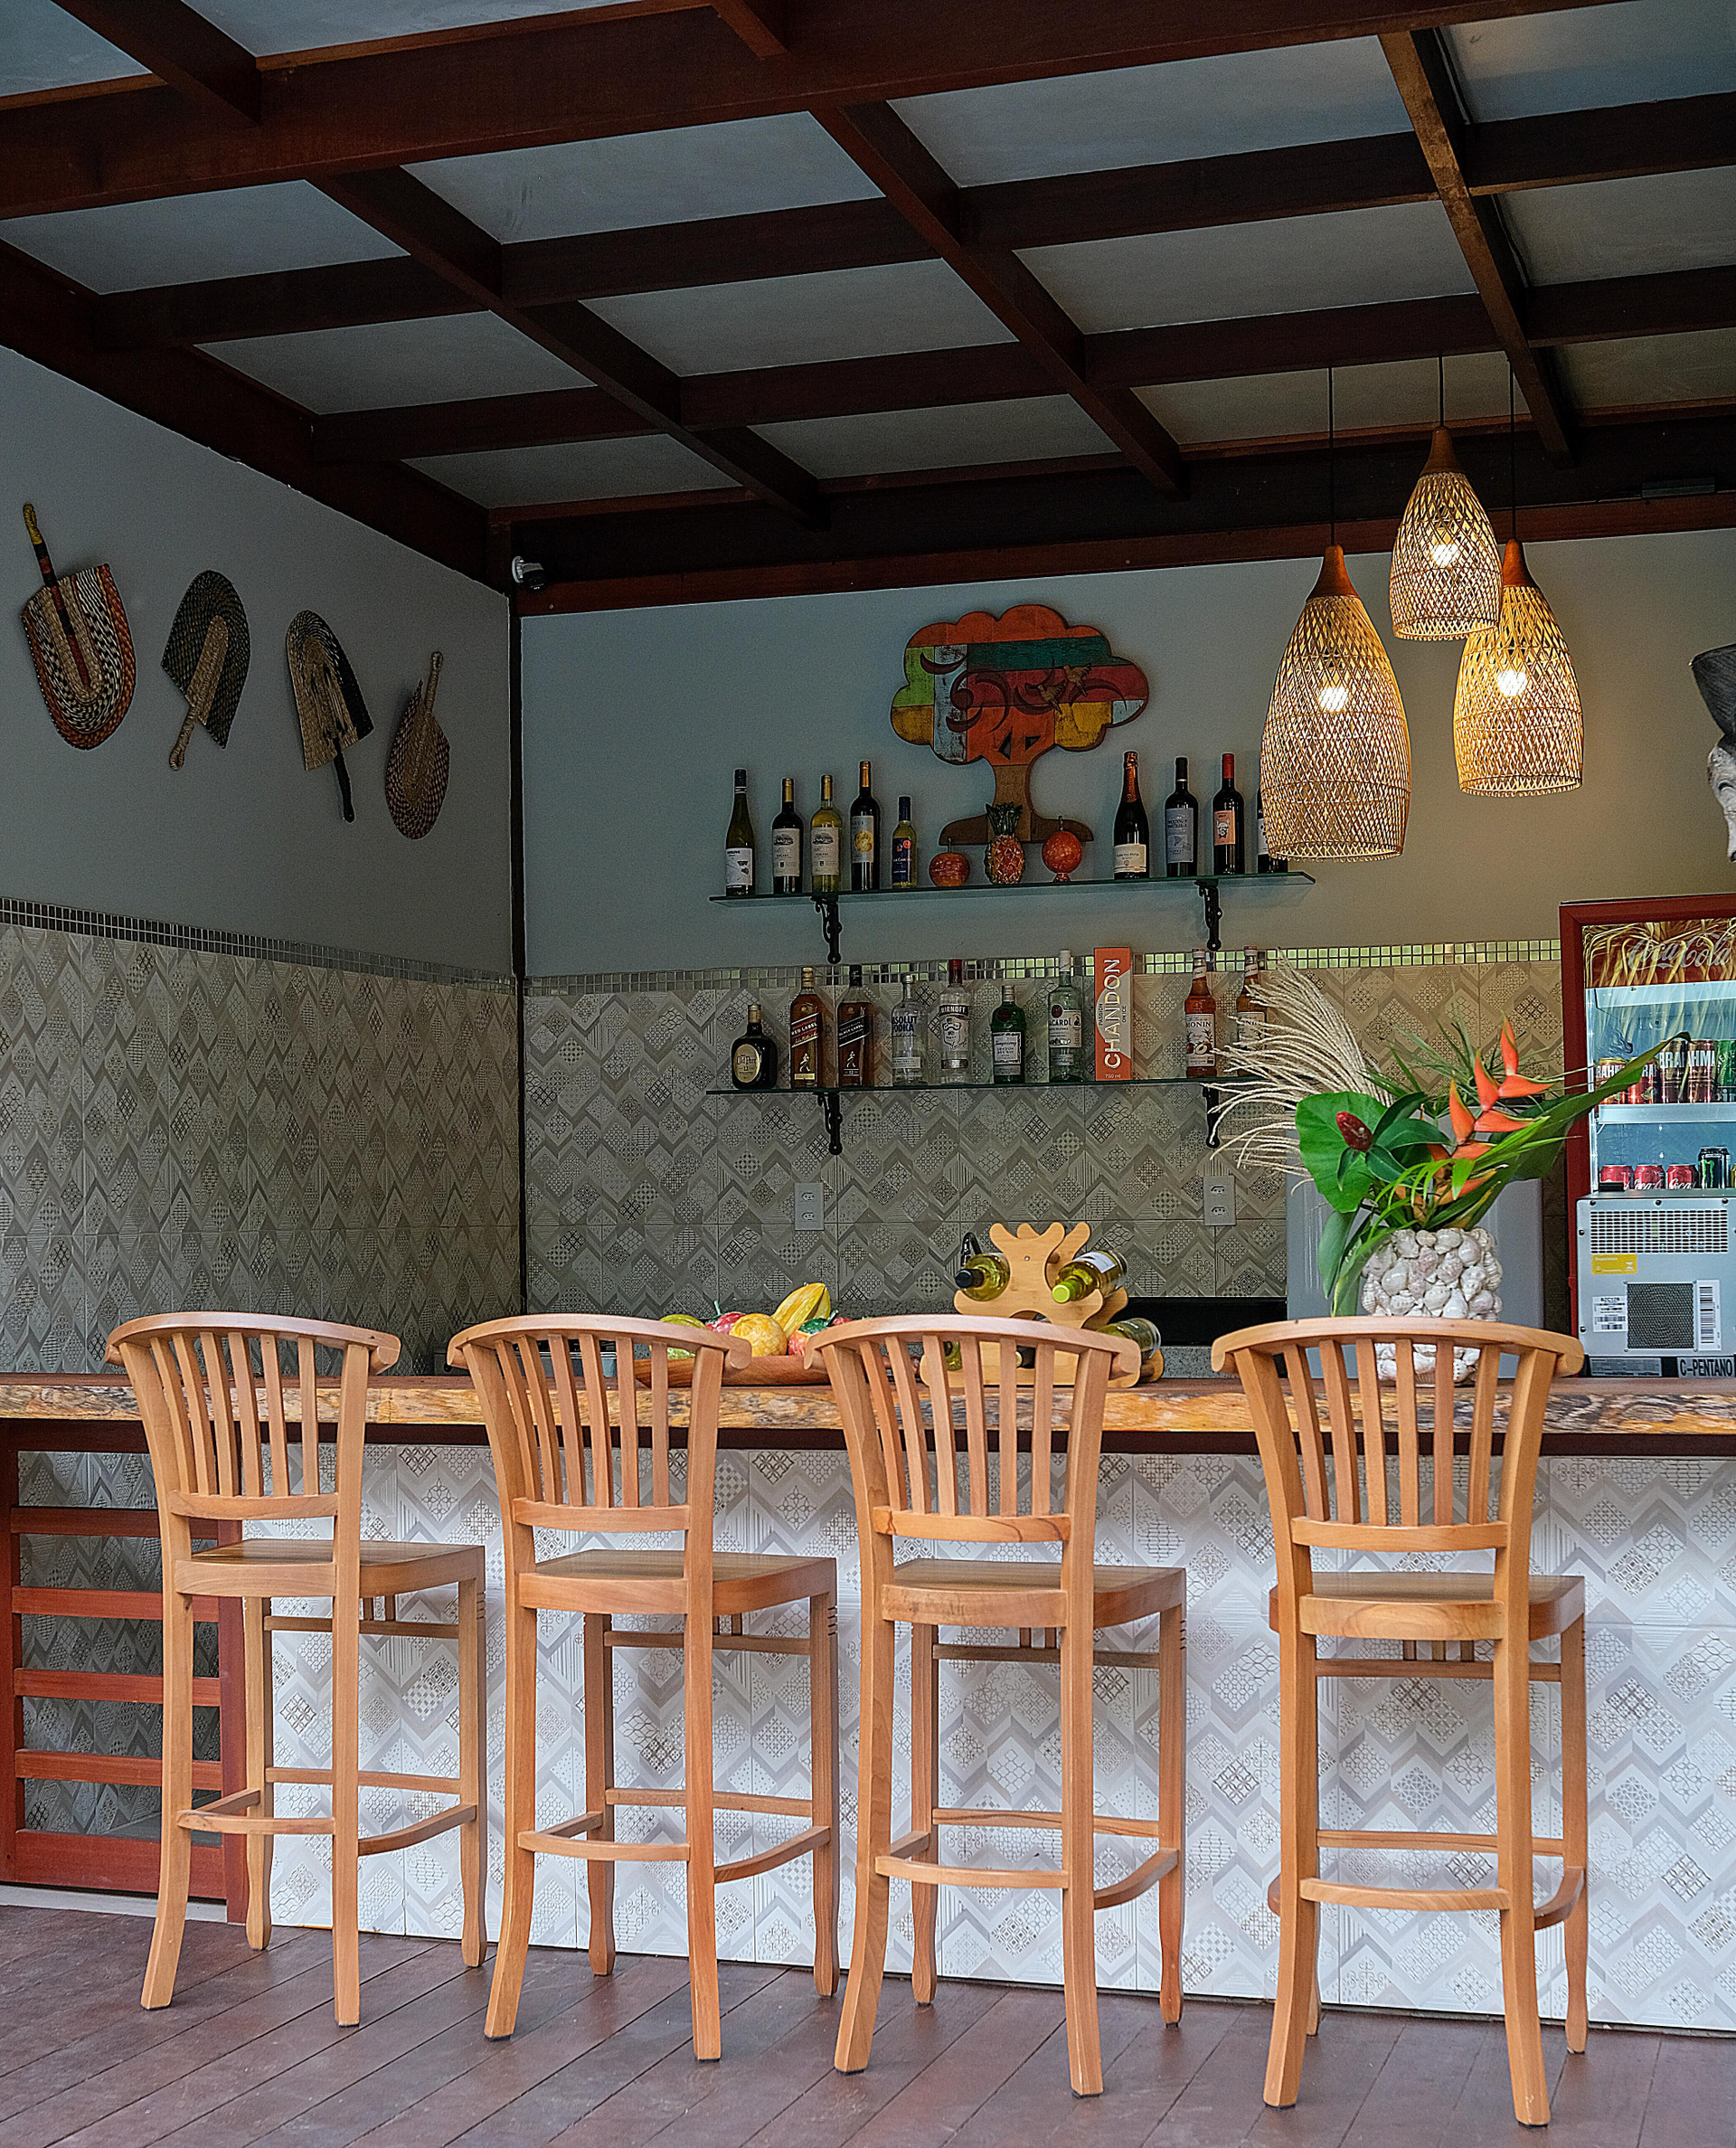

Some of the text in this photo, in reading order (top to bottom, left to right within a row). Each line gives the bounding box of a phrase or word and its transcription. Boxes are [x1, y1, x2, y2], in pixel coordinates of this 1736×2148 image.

[1104, 959, 1121, 1069] CHANDON
[801, 1022, 817, 1031] LABEL
[839, 1028, 851, 1036] BLACK
[851, 1024, 864, 1032] LABEL
[1680, 1358, 1733, 1377] C-PENTANO
